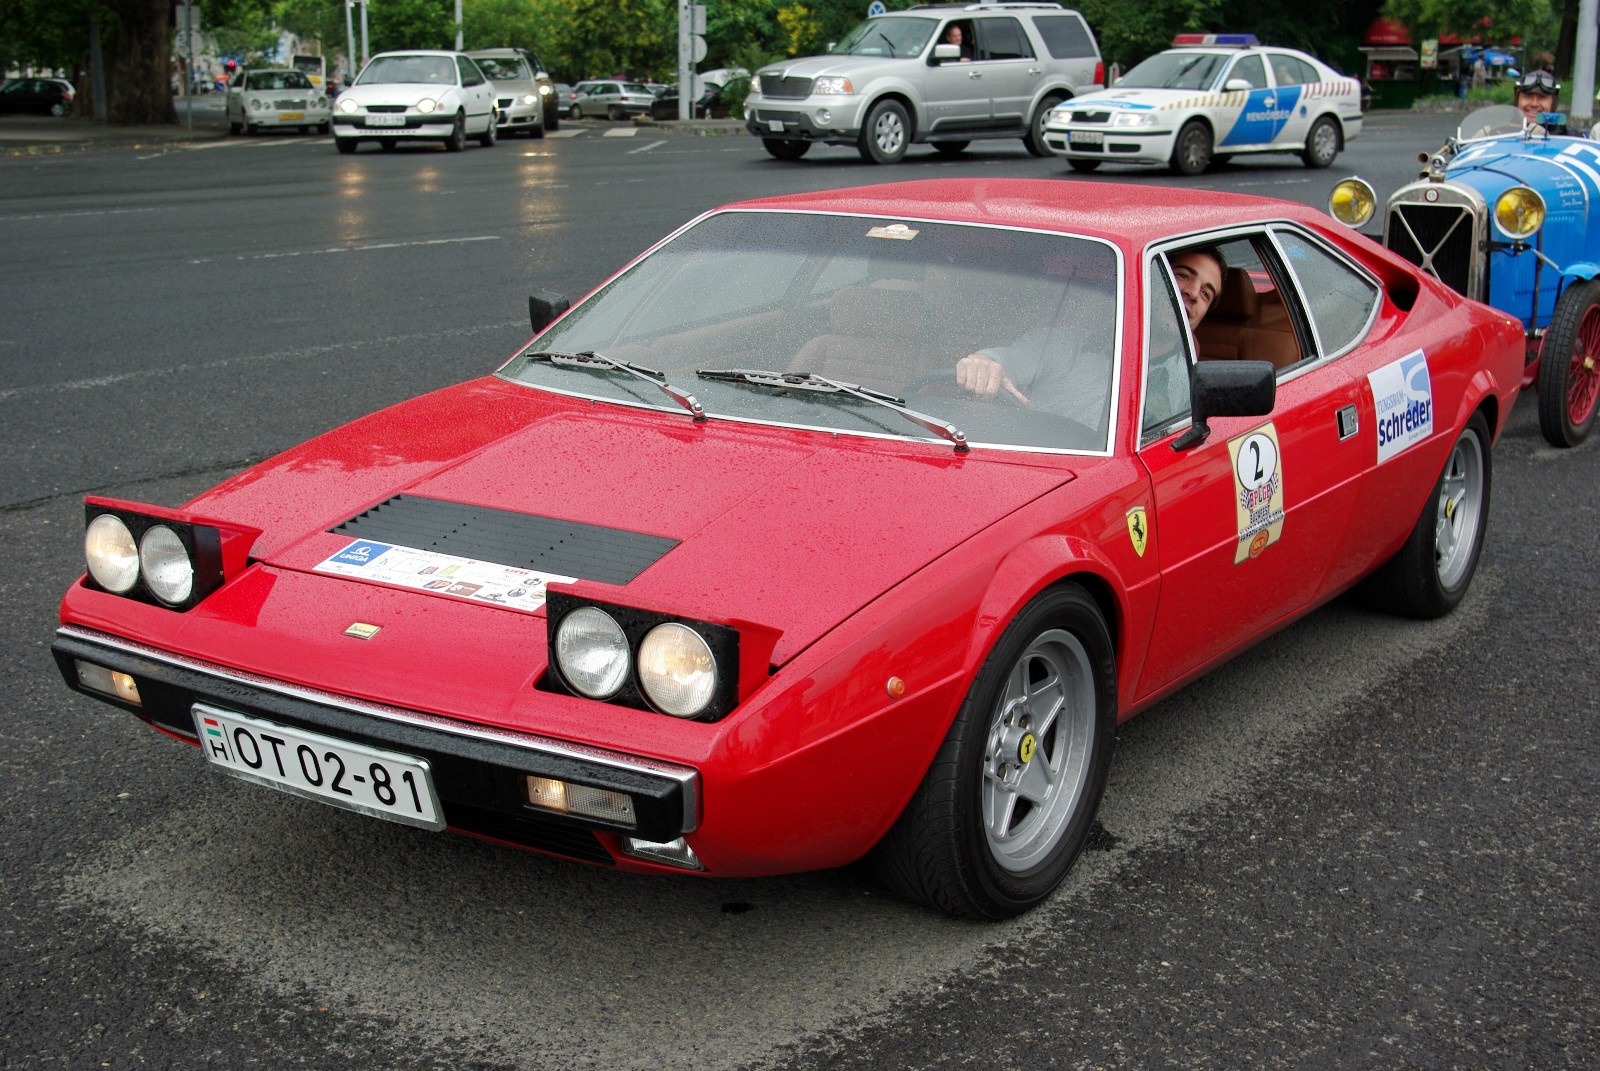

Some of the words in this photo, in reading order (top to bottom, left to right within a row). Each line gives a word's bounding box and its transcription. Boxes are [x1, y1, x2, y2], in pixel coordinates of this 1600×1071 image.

[1378, 398, 1431, 447] Schréder
[1249, 440, 1264, 482] 2
[339, 553, 369, 562] UNIQA
[209, 739, 229, 761] H
[233, 727, 286, 777] OT
[296, 744, 423, 813] 02-81
